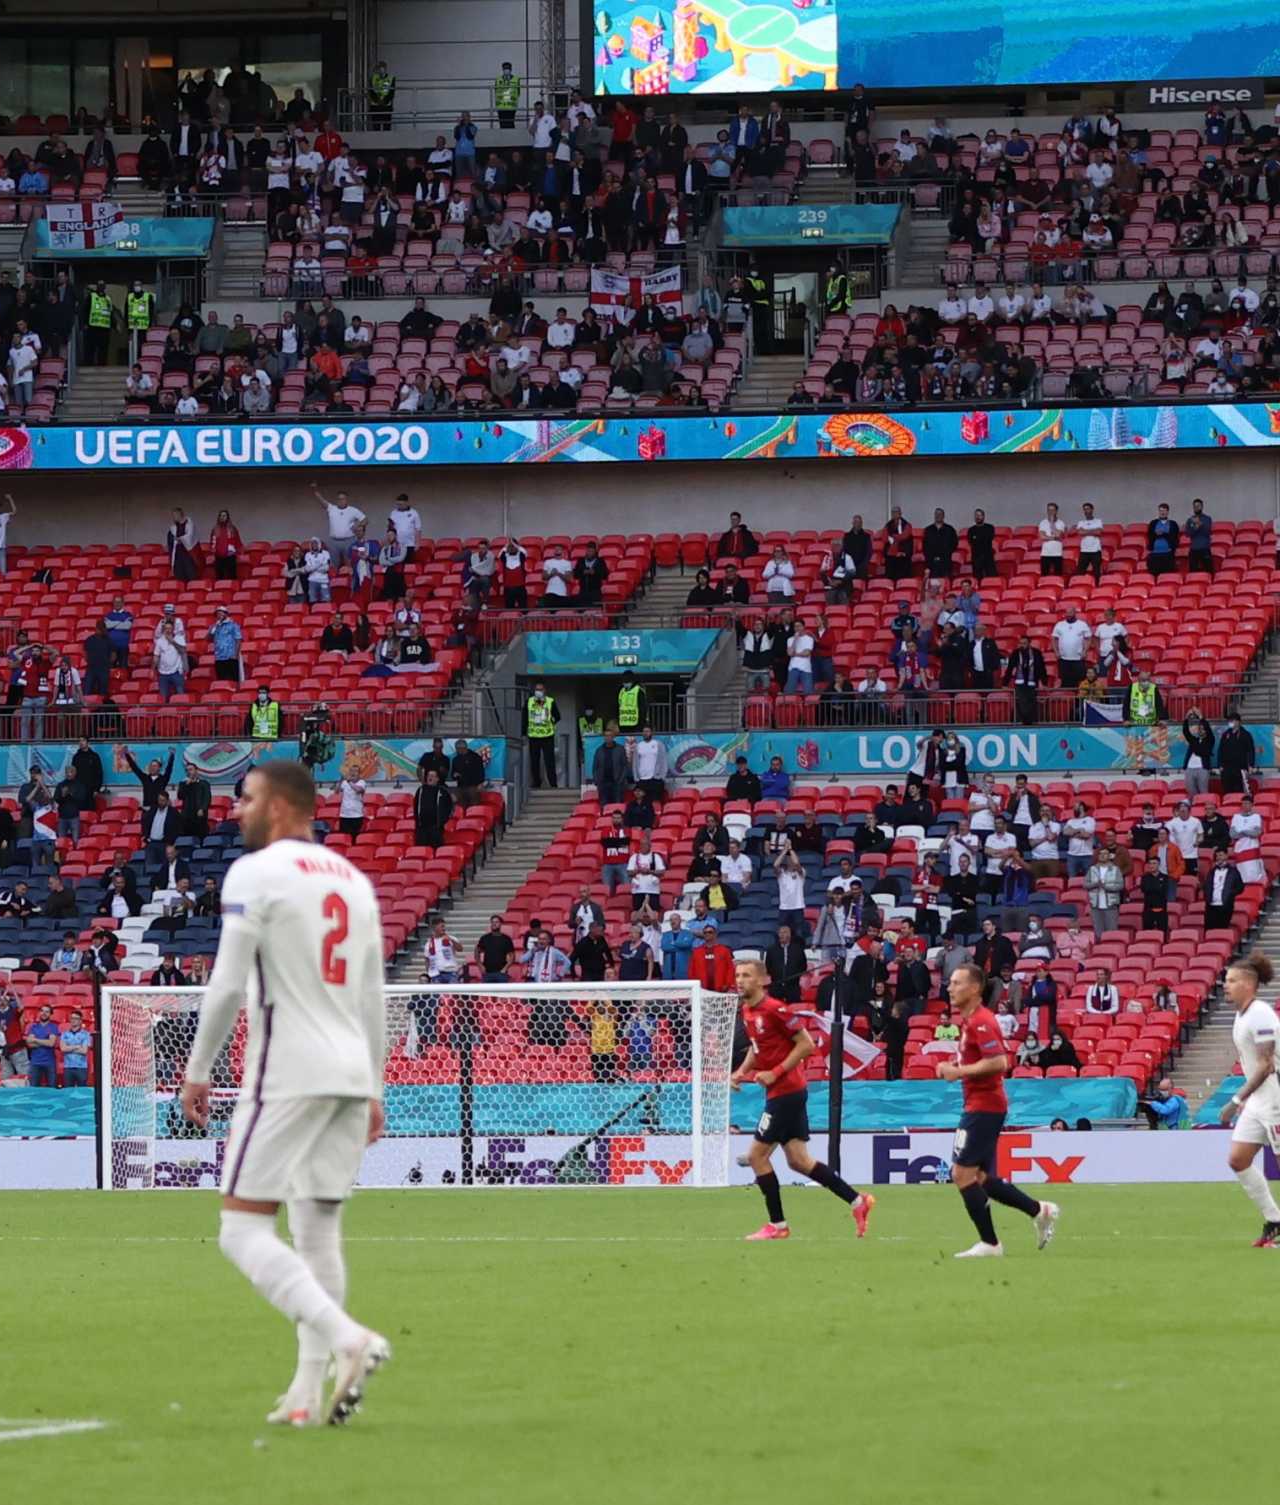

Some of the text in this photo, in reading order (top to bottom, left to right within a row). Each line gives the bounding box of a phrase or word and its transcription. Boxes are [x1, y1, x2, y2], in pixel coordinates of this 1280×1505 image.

[1150, 87, 1252, 104] Hisense
[799, 209, 827, 223] 239
[75, 430, 189, 464] UEFA
[197, 428, 313, 463] EURO
[320, 426, 430, 461] 2020
[611, 634, 641, 650] 133
[321, 892, 349, 985] 2
[873, 1133, 1086, 1184] FeEx
